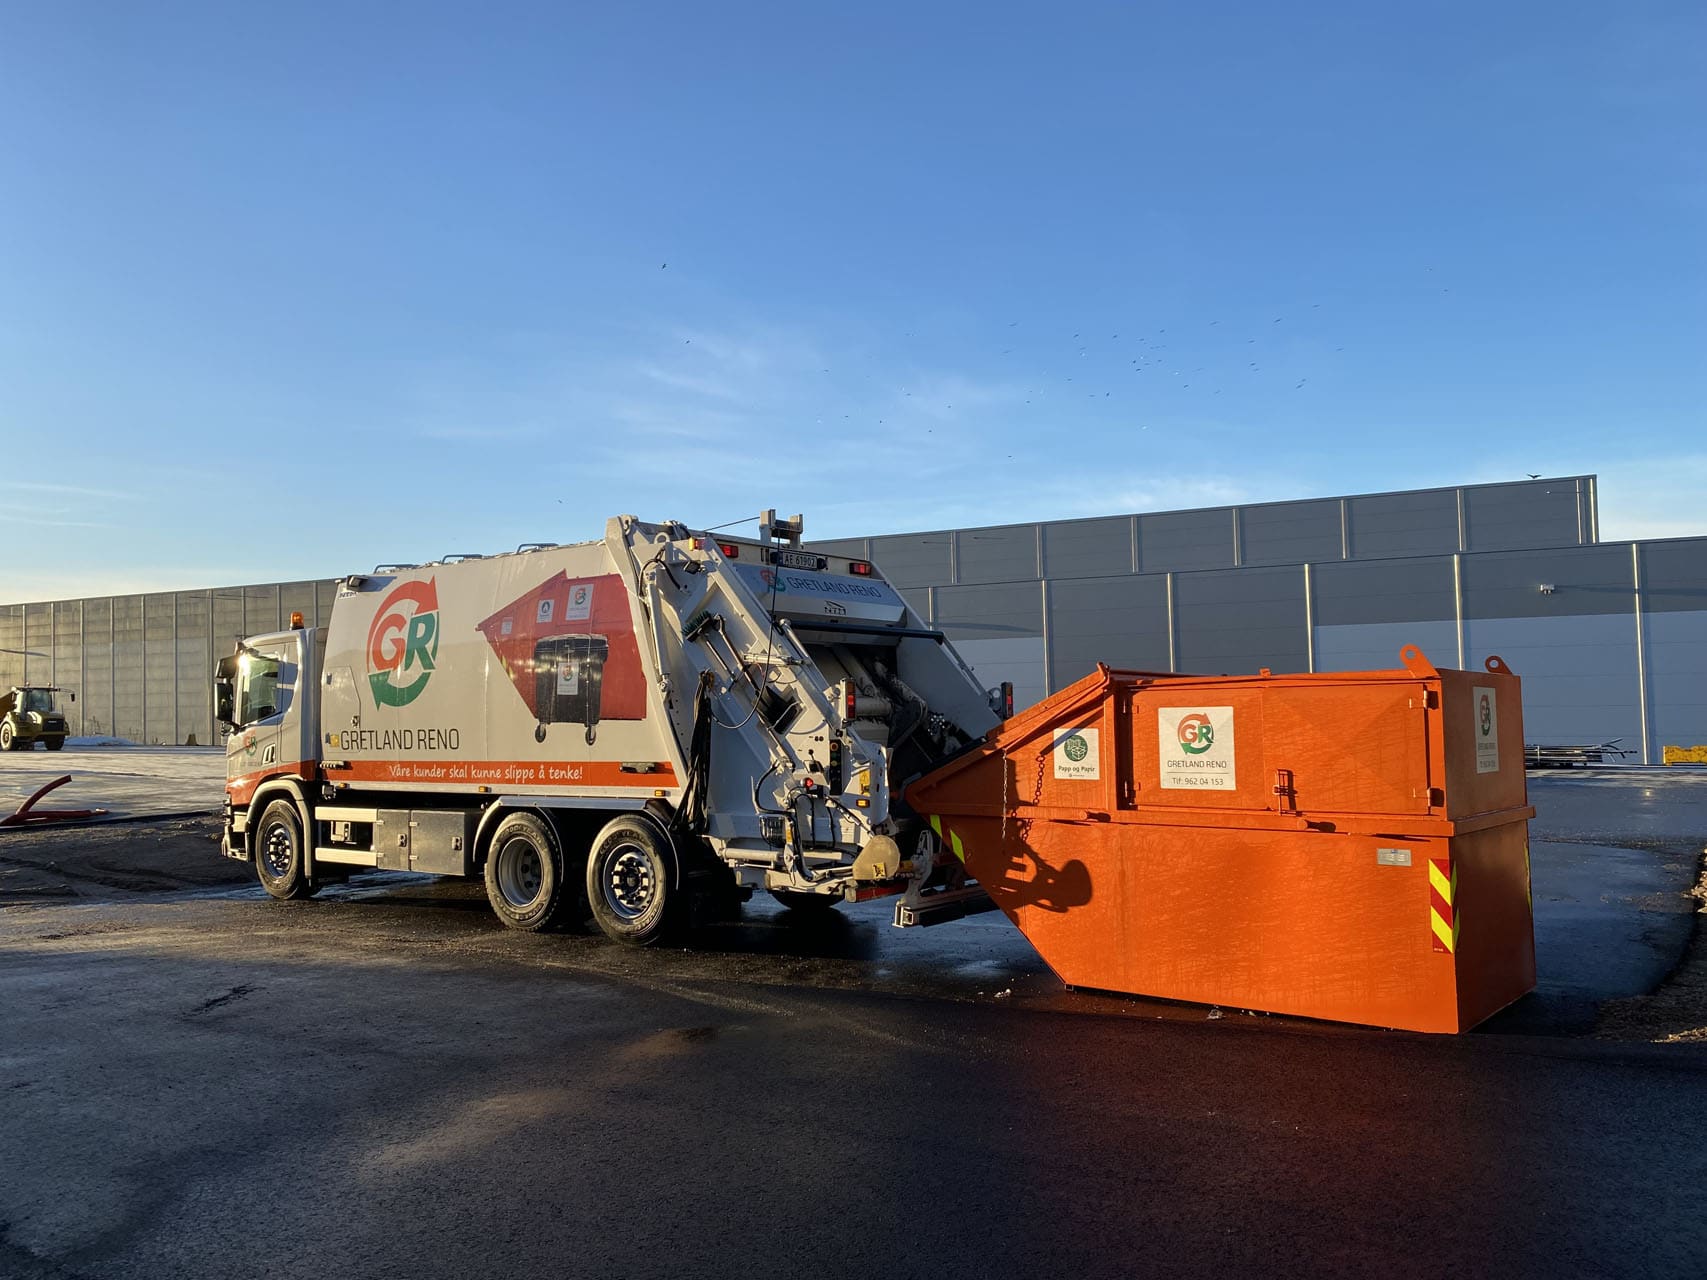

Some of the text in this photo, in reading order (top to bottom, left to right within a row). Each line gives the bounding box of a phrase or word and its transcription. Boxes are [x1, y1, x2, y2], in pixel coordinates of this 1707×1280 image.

[784, 554, 793, 564] AE
[786, 576, 850, 594] GRETLAND
[849, 584, 882, 598] RENO
[372, 613, 436, 671] GR
[340, 728, 460, 750] GRETLAND RENO
[389, 764, 583, 783] Våre kunder skal kunne slippe å tenke!
[1167, 760, 1227, 768] GRETLAND RENO
